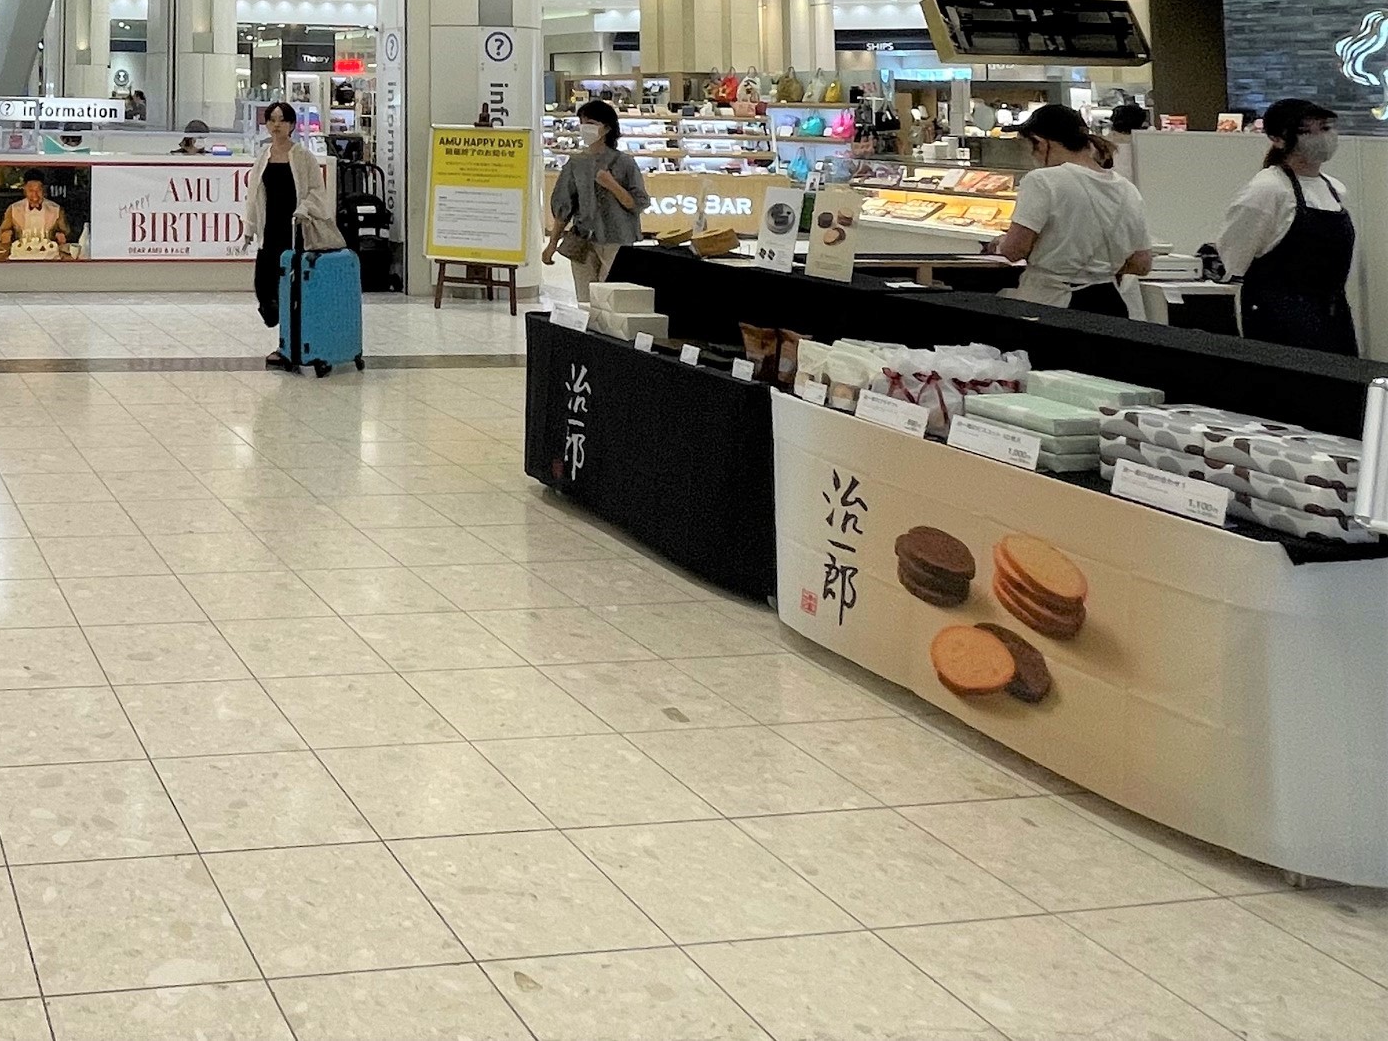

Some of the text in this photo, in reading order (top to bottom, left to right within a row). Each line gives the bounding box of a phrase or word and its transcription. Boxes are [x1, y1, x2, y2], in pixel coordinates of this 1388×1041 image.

[866, 42, 895, 51] SHIPS
[301, 54, 330, 64] Theory
[23, 100, 118, 118] information
[438, 137, 524, 148] AMU HAPPY DAYS
[162, 177, 221, 203] AMU
[643, 194, 752, 215] AC'S BAR
[129, 211, 245, 243] BIRTHD
[564, 362, 592, 481] 治一郎
[822, 468, 869, 626] 治一郎
